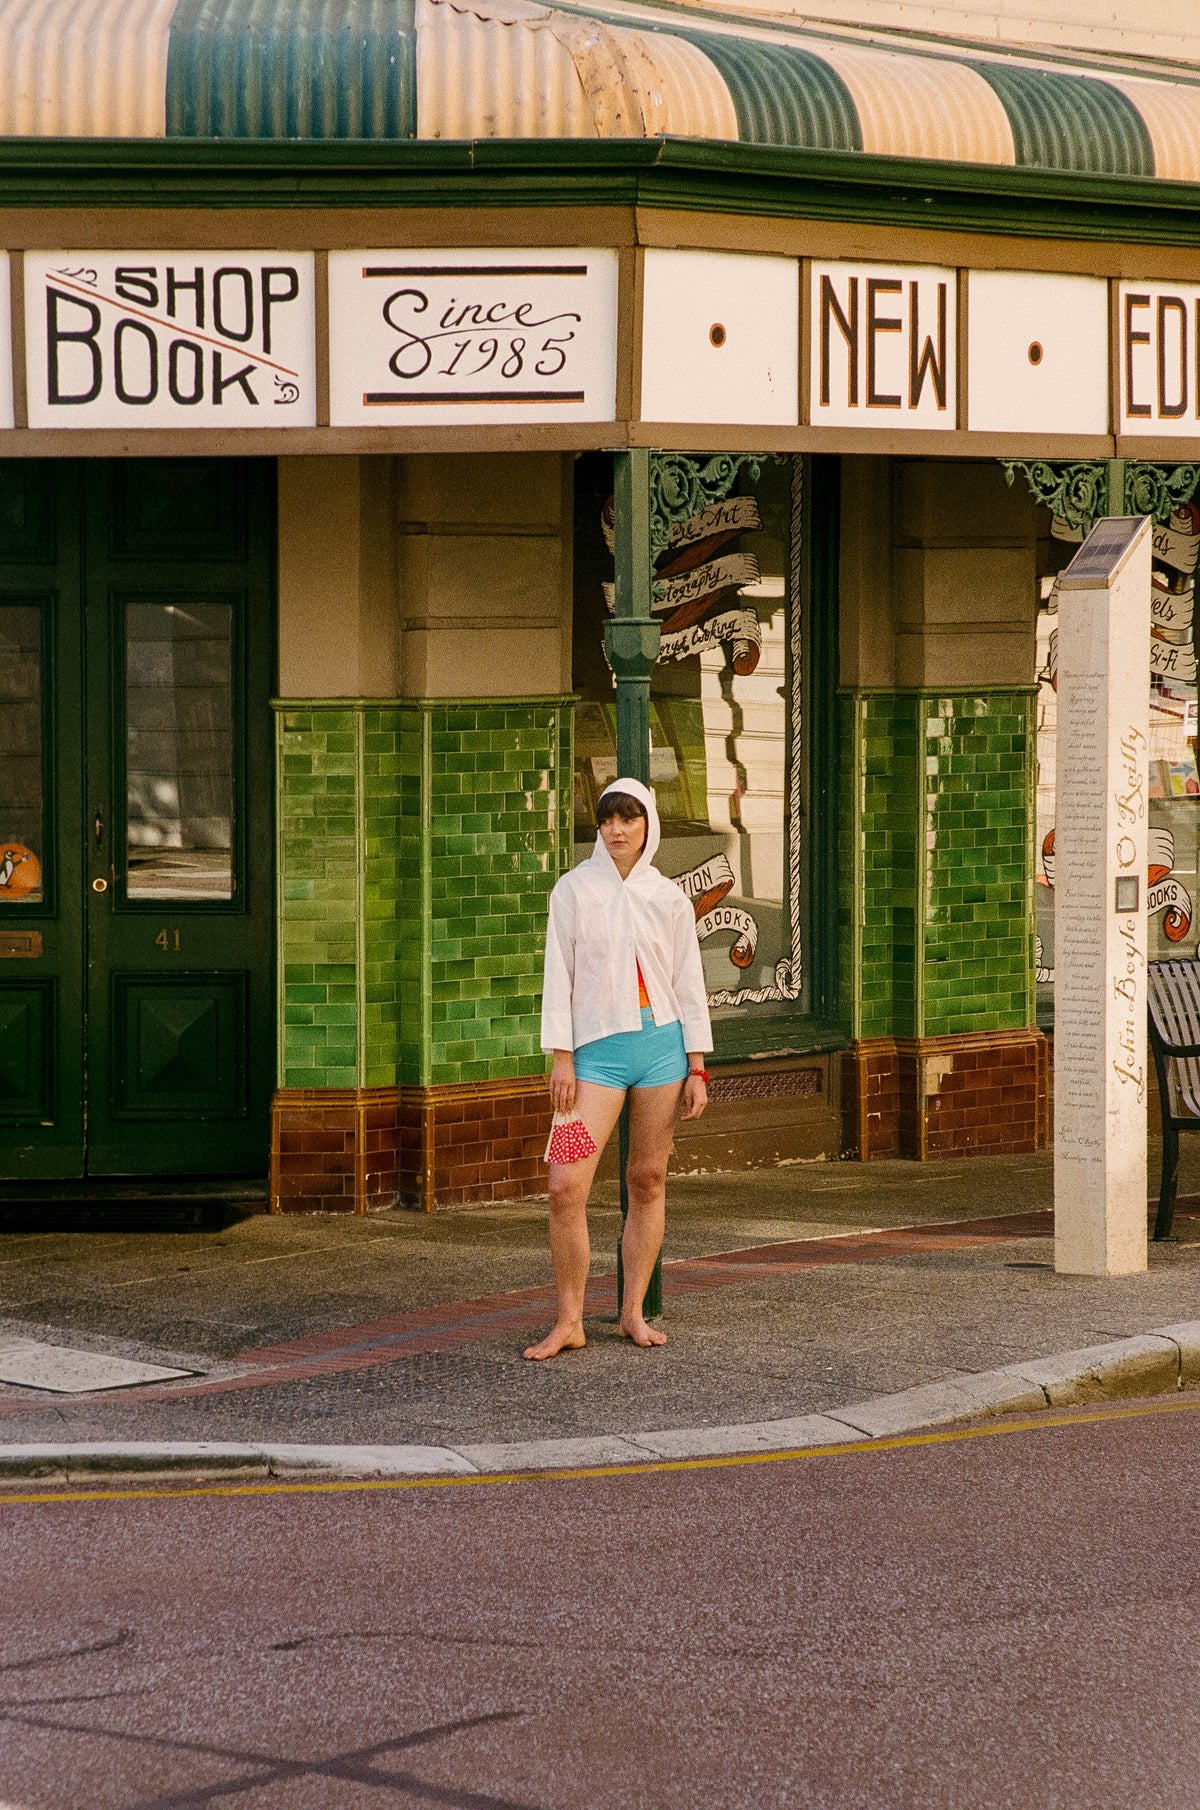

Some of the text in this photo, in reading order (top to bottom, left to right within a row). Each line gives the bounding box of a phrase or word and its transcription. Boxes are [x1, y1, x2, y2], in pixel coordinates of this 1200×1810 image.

[115, 267, 299, 354] SHOP
[382, 288, 581, 379] Since
[819, 274, 947, 411] NEW
[46, 285, 260, 405] BOOK
[437, 330, 575, 377] 1985
[701, 504, 742, 527] Art
[677, 867, 713, 897] TION
[1113, 724, 1148, 1104] John Boyle O'Reilly
[155, 929, 182, 952] 41
[704, 910, 752, 932] BOOKS
